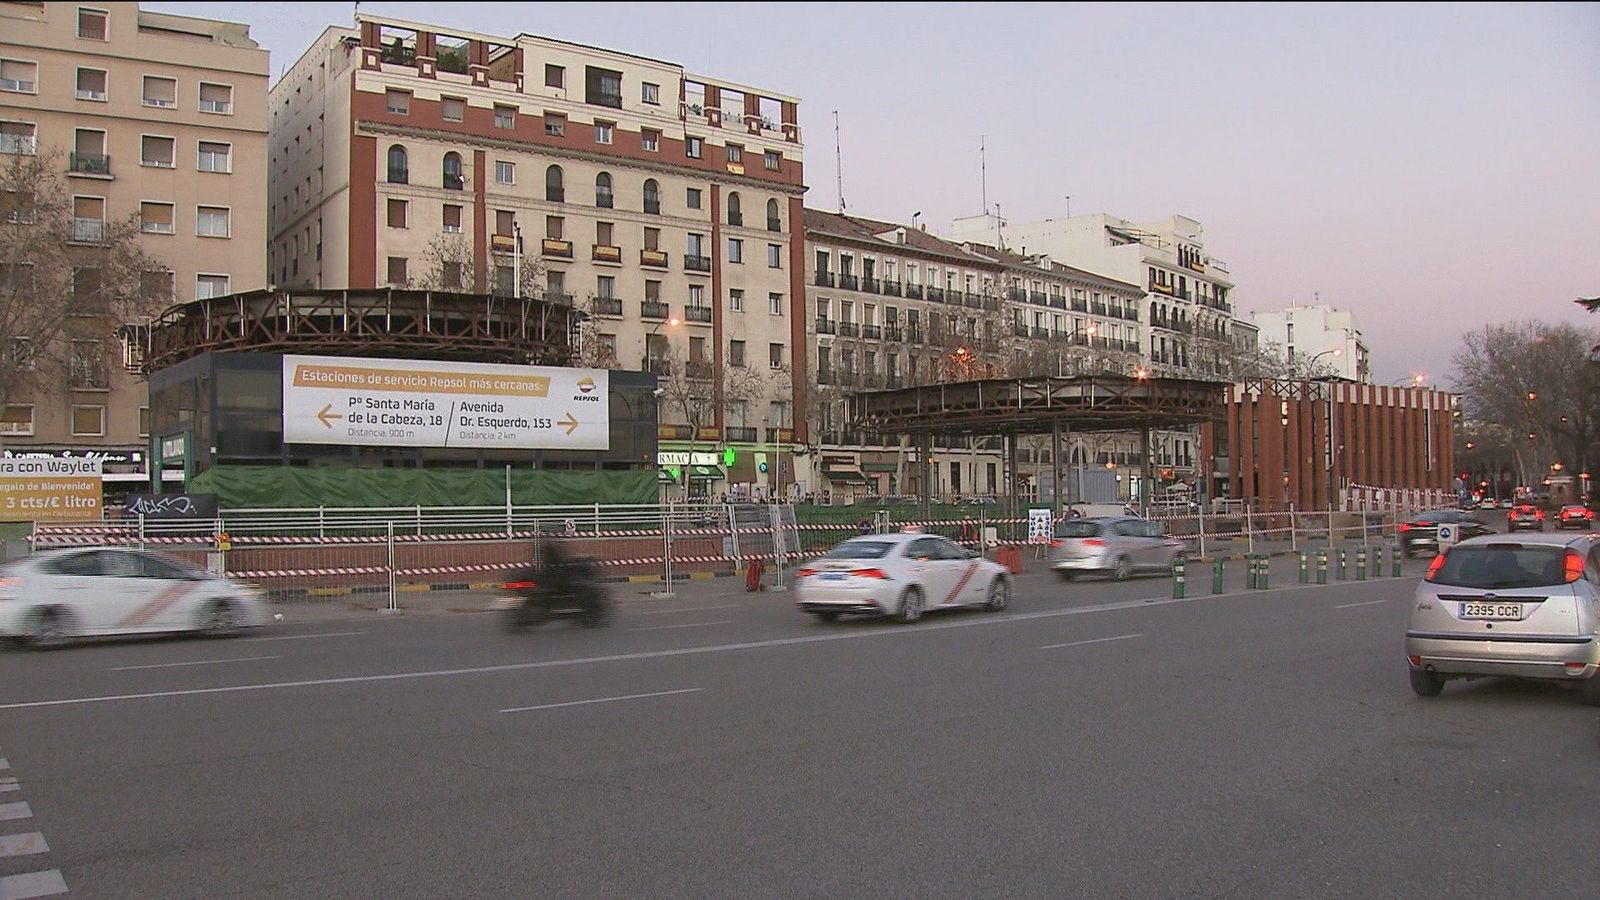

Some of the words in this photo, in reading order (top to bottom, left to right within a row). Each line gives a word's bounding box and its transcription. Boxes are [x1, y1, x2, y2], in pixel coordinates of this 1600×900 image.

[302, 370, 365, 384] Estaciones
[367, 373, 382, 385] de
[384, 375, 427, 387] servicio
[430, 377, 467, 390] Repsol
[469, 378, 492, 389] más
[494, 380, 544, 391] cercanas:
[365, 398, 400, 410] Santa
[403, 398, 435, 411] María
[460, 401, 504, 413] Avenida
[348, 412, 363, 423] de
[366, 413, 378, 424] la
[381, 413, 426, 427] Cabeza,
[429, 415, 443, 426] 18
[460, 416, 475, 427] Dr.
[477, 417, 531, 430] Esquerdo,
[533, 418, 552, 429] 153
[347, 428, 386, 437] Distancia:
[388, 429, 405, 438] 900
[406, 430, 415, 438] m
[497, 431, 503, 440] 2
[503, 431, 516, 440] km
[18, 463, 43, 473] con
[46, 460, 97, 476] Waylet
[27, 482, 40, 491] de
[41, 481, 95, 491] Bienvenida!
[6, 496, 15, 509] 3
[1466, 604, 1494, 616] 2395
[1497, 605, 1519, 617] CCR
